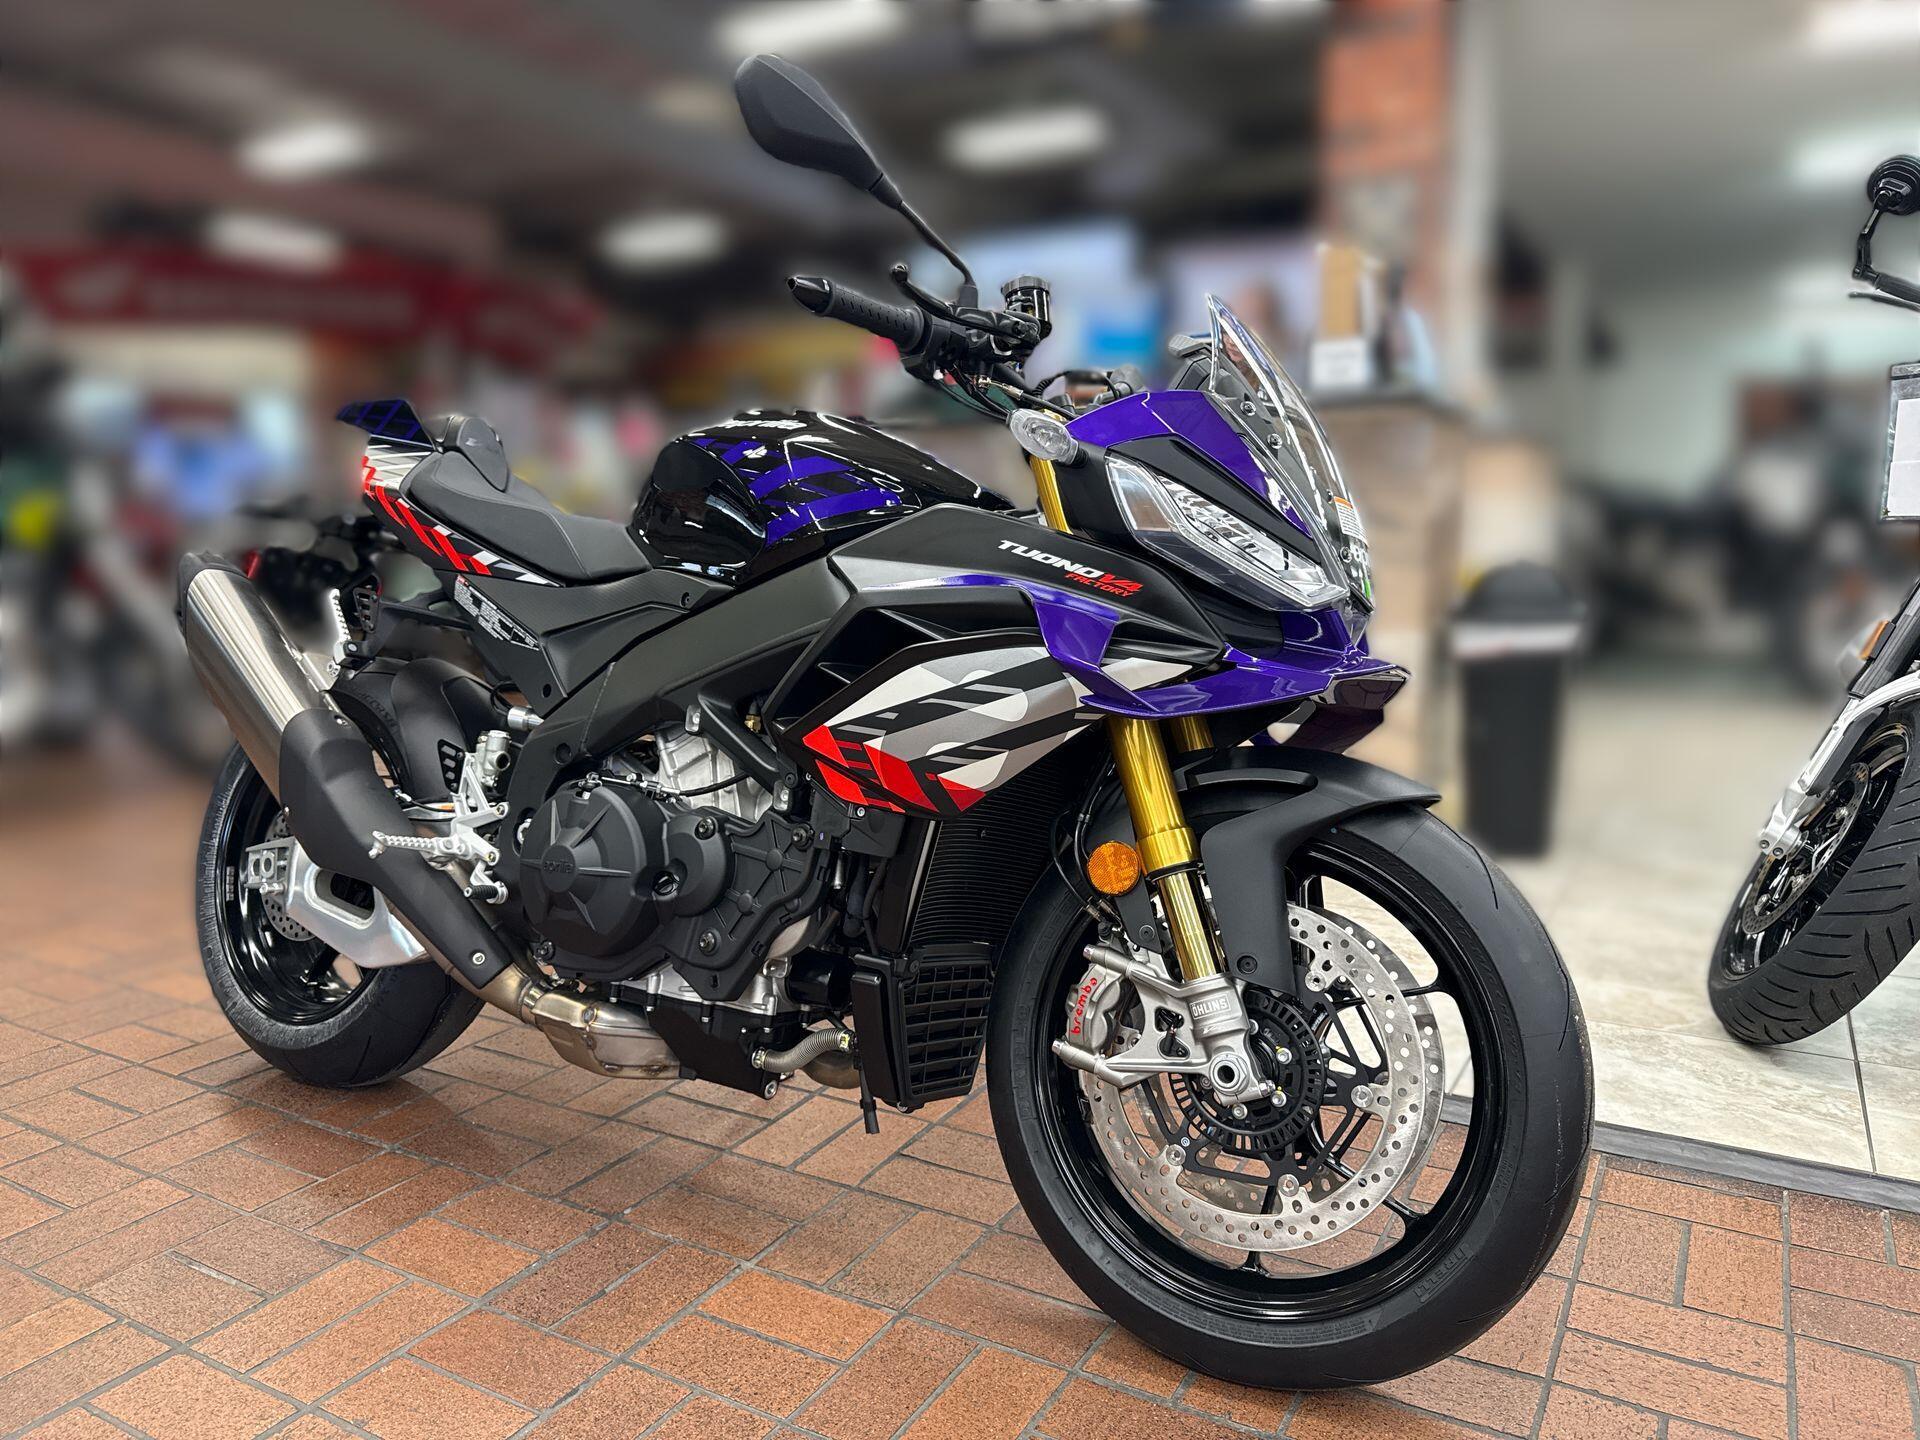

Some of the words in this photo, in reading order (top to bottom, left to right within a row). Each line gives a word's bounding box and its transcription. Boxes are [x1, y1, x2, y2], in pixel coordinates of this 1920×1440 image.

[998, 539, 1105, 579] TUONO
[1099, 572, 1144, 592] V4
[1065, 572, 1136, 598] FACTORY
[1070, 977, 1098, 1034] brembo
[1192, 999, 1228, 1018] ÖHLINS
